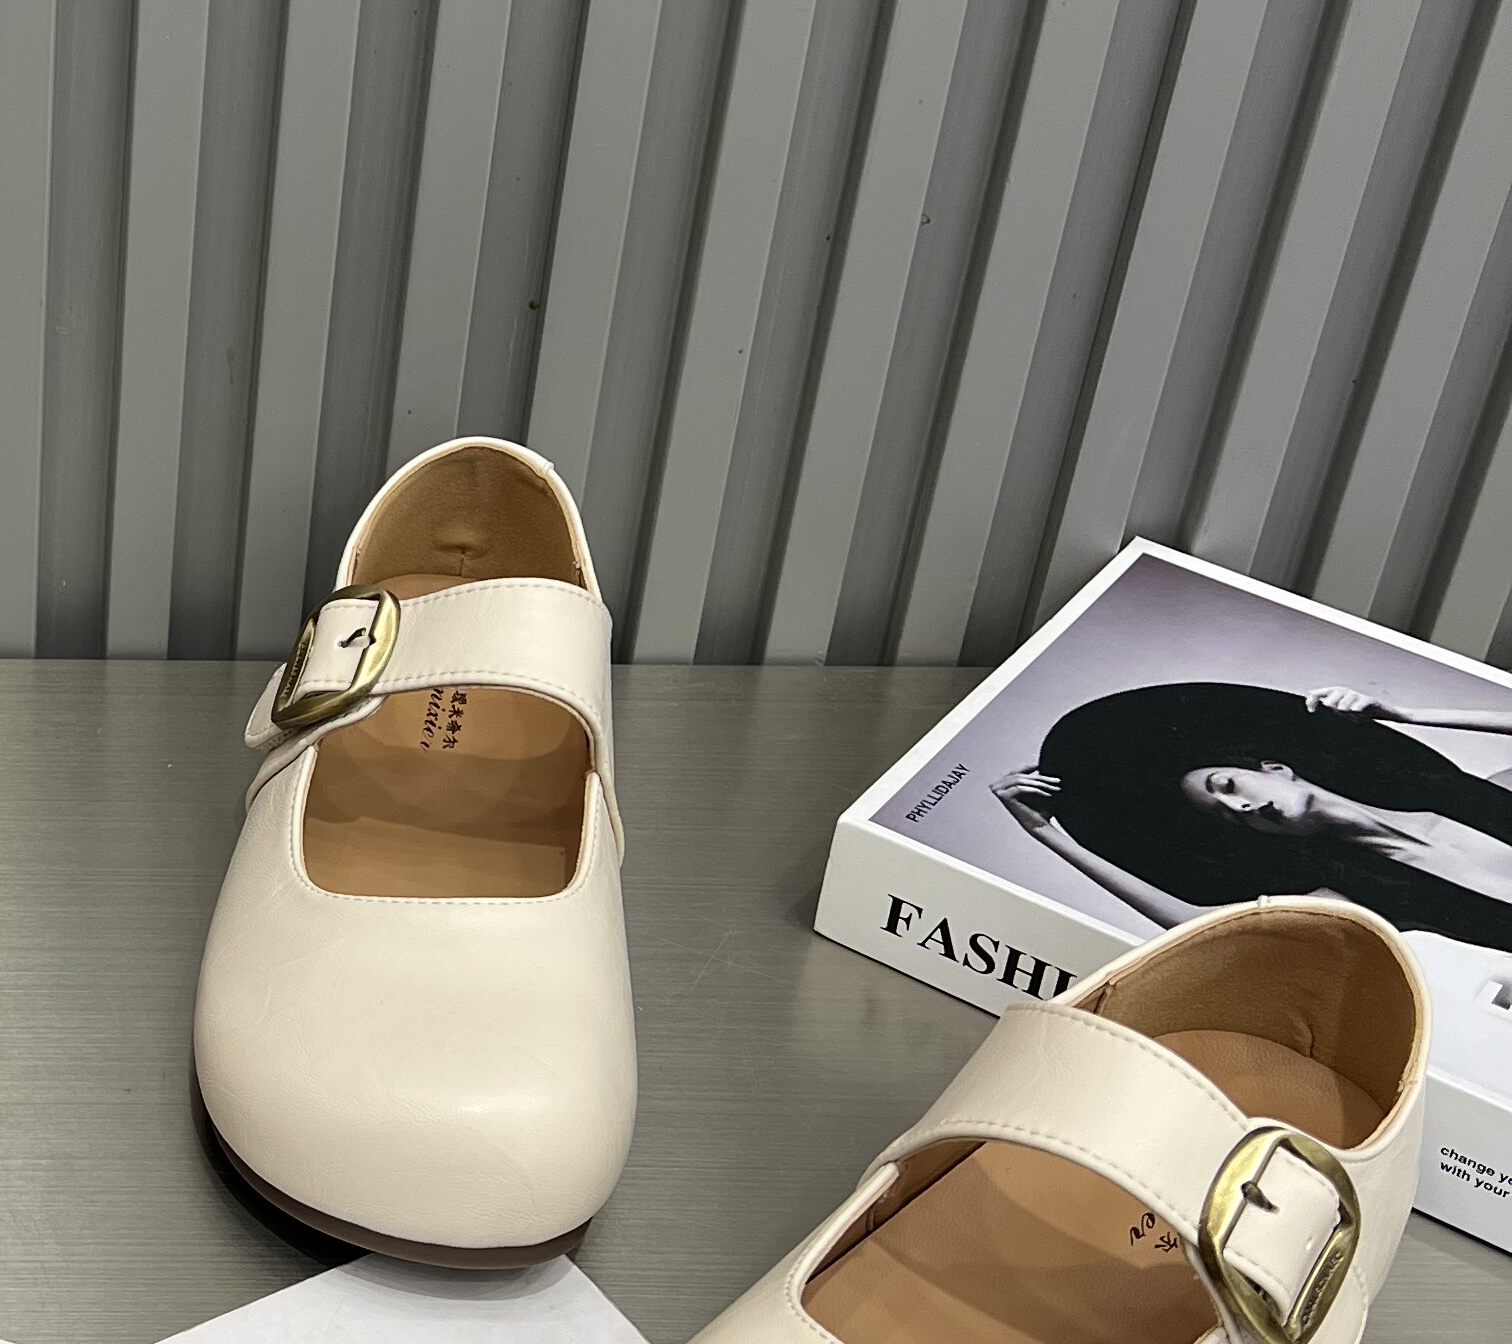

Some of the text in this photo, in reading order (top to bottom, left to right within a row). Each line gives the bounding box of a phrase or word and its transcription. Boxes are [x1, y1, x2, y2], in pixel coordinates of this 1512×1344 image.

[1440, 1147, 1496, 1177] change
[1440, 1162, 1510, 1198] with your
